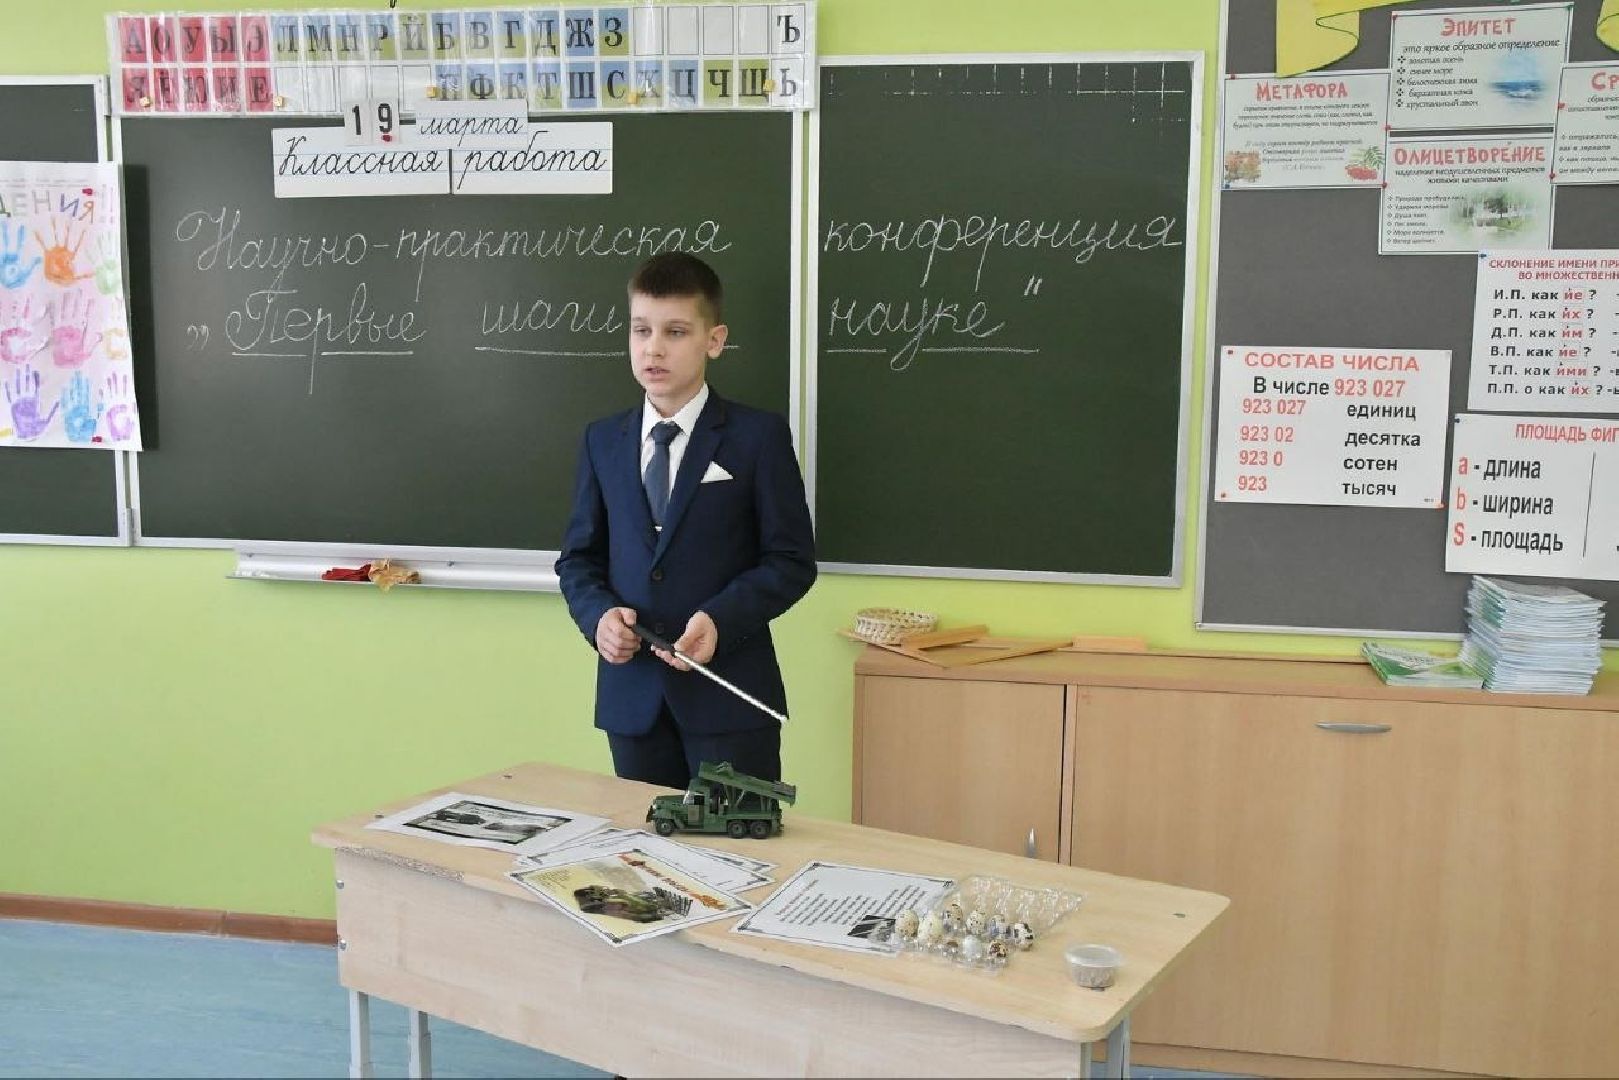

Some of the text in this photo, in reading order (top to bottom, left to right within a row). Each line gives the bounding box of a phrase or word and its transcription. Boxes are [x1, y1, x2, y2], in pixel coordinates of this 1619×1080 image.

[182, 26, 203, 54] У
[209, 24, 237, 54] Ы
[246, 24, 264, 54] Э
[276, 24, 299, 52] Л
[307, 24, 333, 52] М
[336, 24, 360, 52] Н
[369, 23, 389, 51] Р
[435, 20, 455, 51] Б
[469, 21, 490, 50] В
[503, 19, 520, 49] Г
[535, 19, 557, 56] Д
[565, 16, 595, 49] Ж
[604, 16, 623, 47] З
[776, 14, 801, 43] Ъ
[1440, 17, 1518, 37] ЭПИТЕТ
[469, 72, 495, 100] Ф
[501, 72, 526, 99] К
[537, 71, 558, 100] Т
[568, 71, 596, 99] Ш
[607, 69, 626, 100] С
[671, 68, 696, 103] Ц
[707, 68, 731, 98] Ч
[738, 68, 770, 103] Щ
[779, 68, 797, 97] Ь
[349, 103, 523, 147] 19 марта
[278, 130, 608, 190] Классная работа
[824, 214, 1183, 292] конференция
[1489, 259, 1554, 269] СКЛОНЕНИЕ
[1558, 259, 1597, 269] ИМЕНИ
[1518, 270, 1533, 280] ВО
[1494, 289, 1526, 300] И.П.
[1531, 291, 1559, 300] как
[481, 300, 623, 335] шаги
[1492, 308, 1523, 319] Р.П.
[1529, 310, 1556, 319] как
[1491, 327, 1523, 339] Д.П.
[1529, 329, 1557, 338] как
[1244, 352, 1420, 372] СОСТАВ ЧИСЛА
[1490, 346, 1521, 357] В.П.
[1526, 348, 1554, 357] как
[1488, 364, 1518, 376] Т.П.
[1524, 367, 1551, 376] как
[1253, 376, 1406, 398] В числе 923 027
[1487, 383, 1518, 394] П.П.
[1524, 386, 1533, 395] о
[1539, 385, 1566, 395] как
[1242, 398, 1417, 420] 923 027 единиц
[1240, 426, 1421, 447] 923 02 десятка
[1515, 423, 1587, 443] ПЛОЩАДЬ
[1239, 450, 1267, 465] 923
[1343, 457, 1398, 471] сотен
[1483, 459, 1541, 481] длина
[1238, 475, 1397, 496] 923 тысяч
[1483, 494, 1554, 519] ширина
[1481, 530, 1564, 555] площадь
